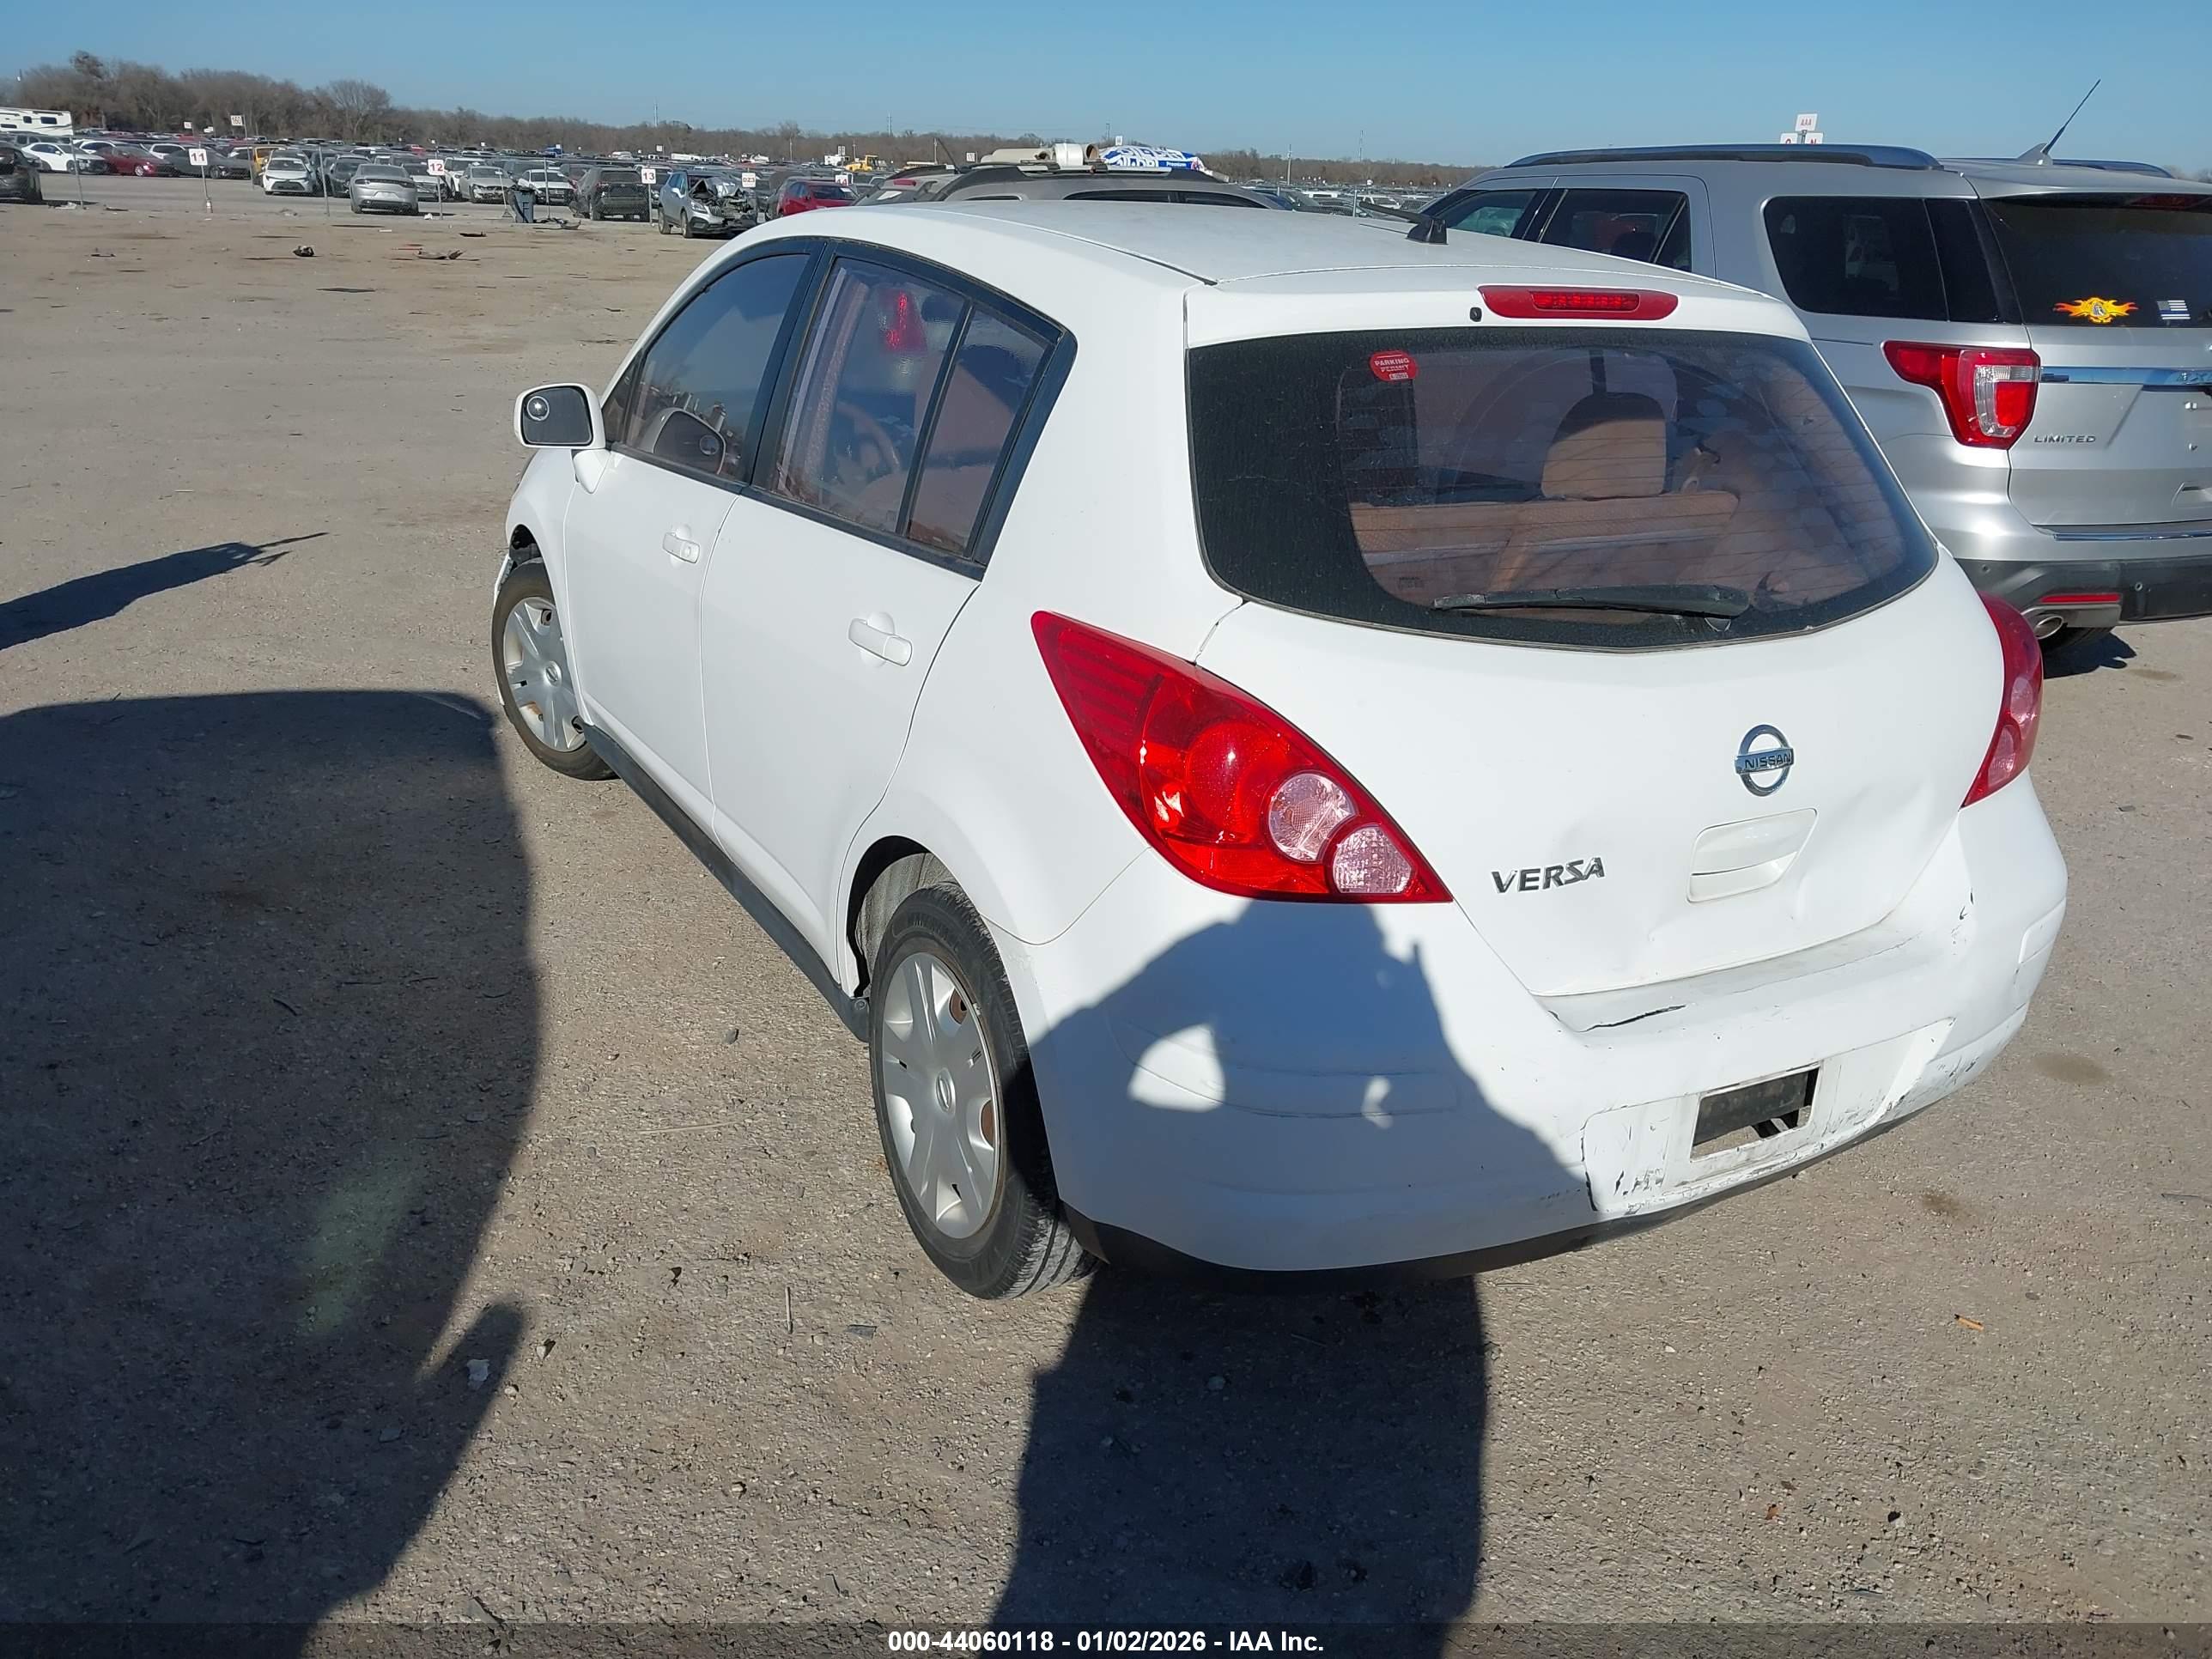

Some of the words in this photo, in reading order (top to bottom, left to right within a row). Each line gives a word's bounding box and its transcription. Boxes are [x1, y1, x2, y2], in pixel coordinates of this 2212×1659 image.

[191, 152, 205, 161] 11
[430, 163, 444, 172] 12
[642, 172, 655, 180] 13
[1374, 357, 1410, 368] PARKING
[2033, 434, 2096, 443] LIMITED
[1743, 752, 1792, 770] NISSAN
[1492, 856, 1605, 894] VERSA
